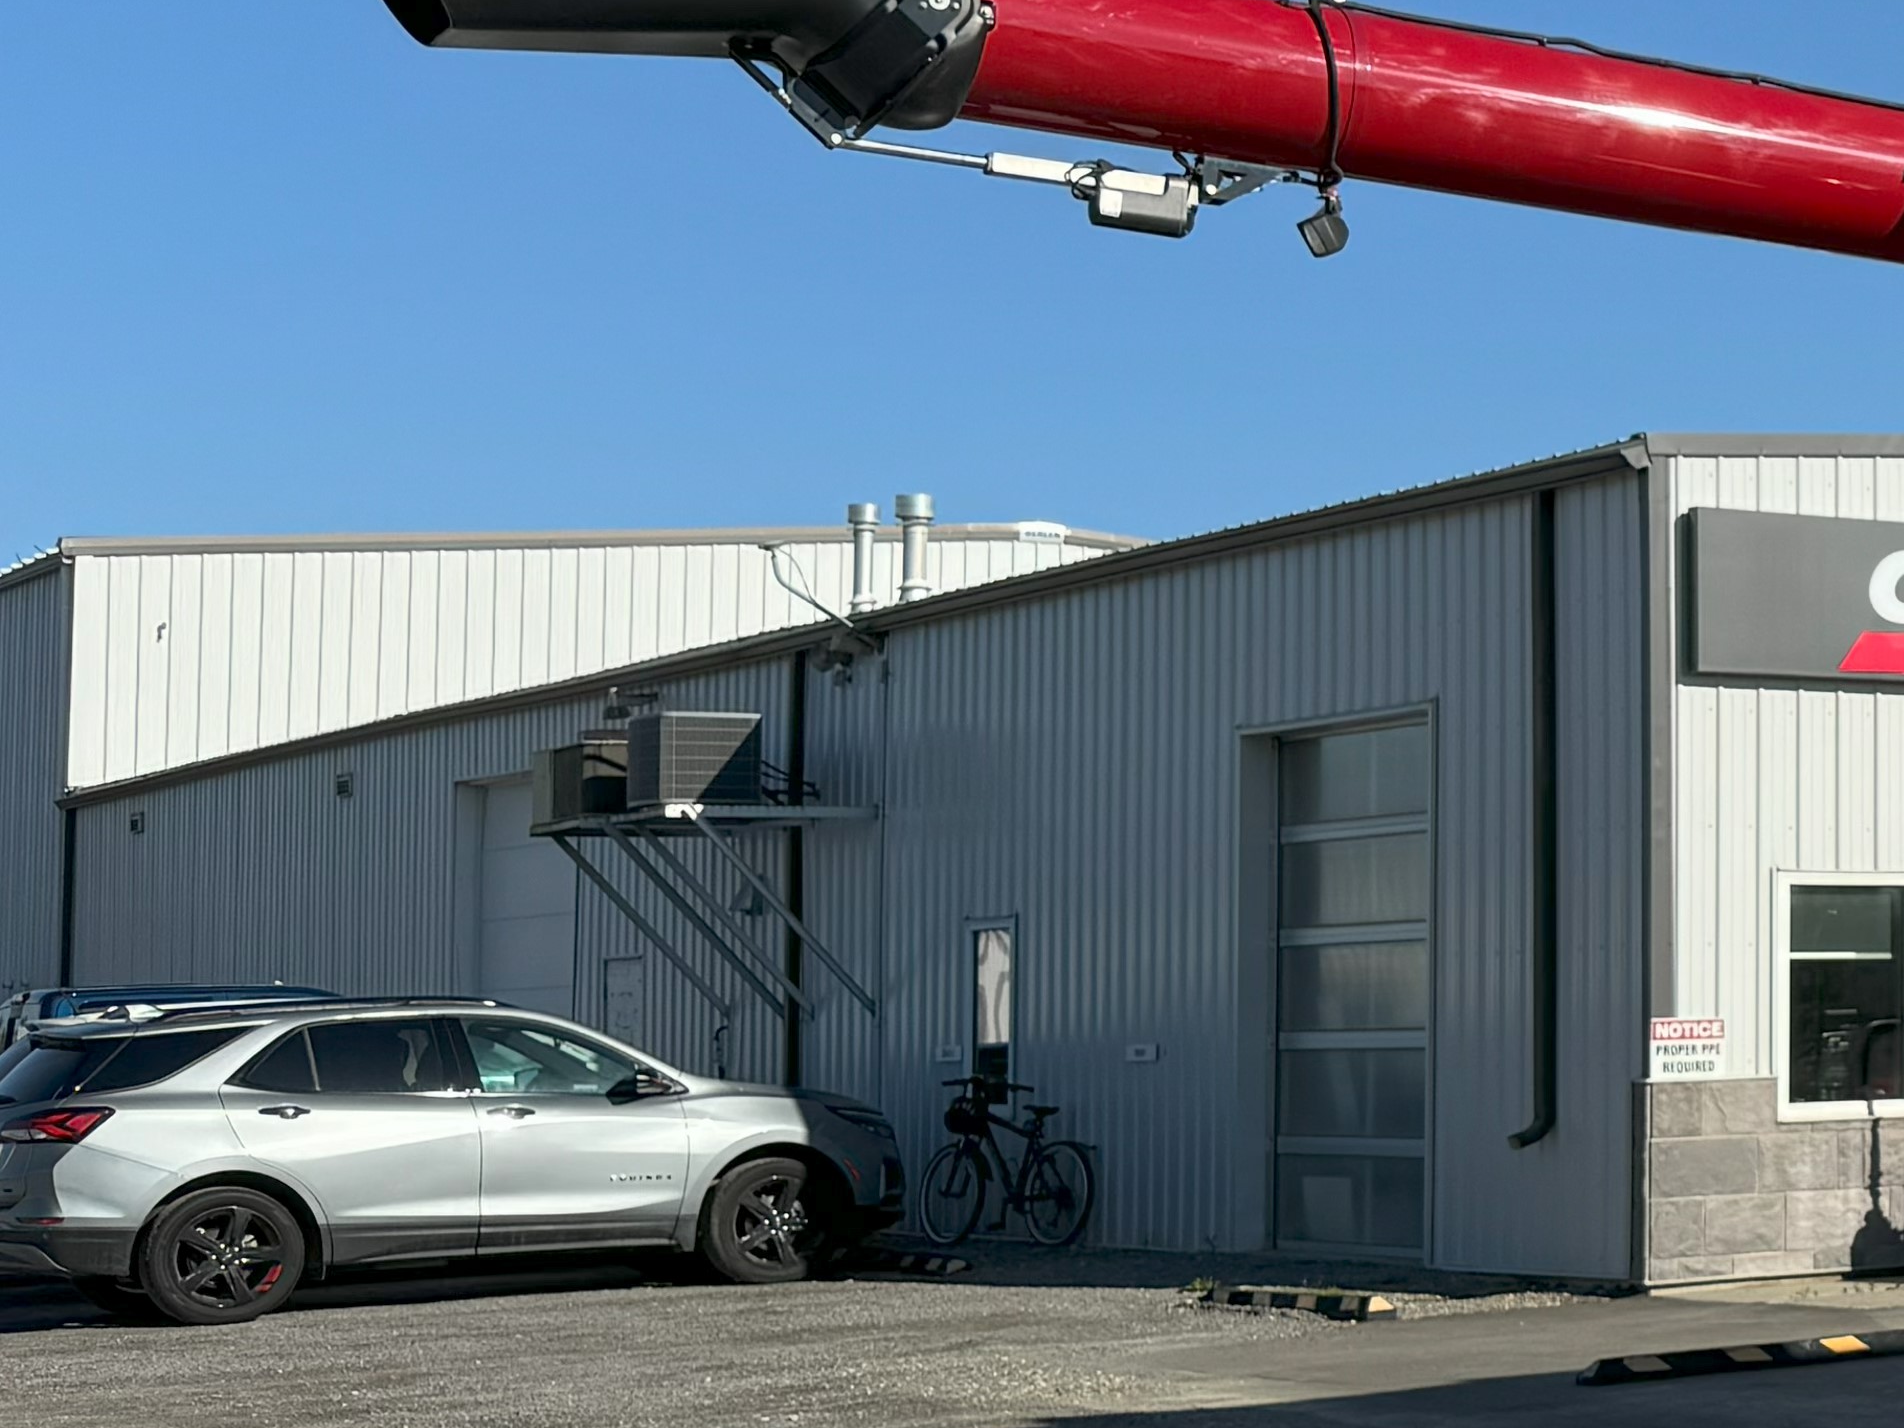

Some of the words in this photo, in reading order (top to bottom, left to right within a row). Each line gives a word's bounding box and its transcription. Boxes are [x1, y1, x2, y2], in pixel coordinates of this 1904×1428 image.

[1655, 1021, 1723, 1039] NOTICE
[1656, 1044, 1698, 1056] PROPER
[1702, 1043, 1720, 1055] PPE
[1662, 1060, 1715, 1073] REQUIRED
